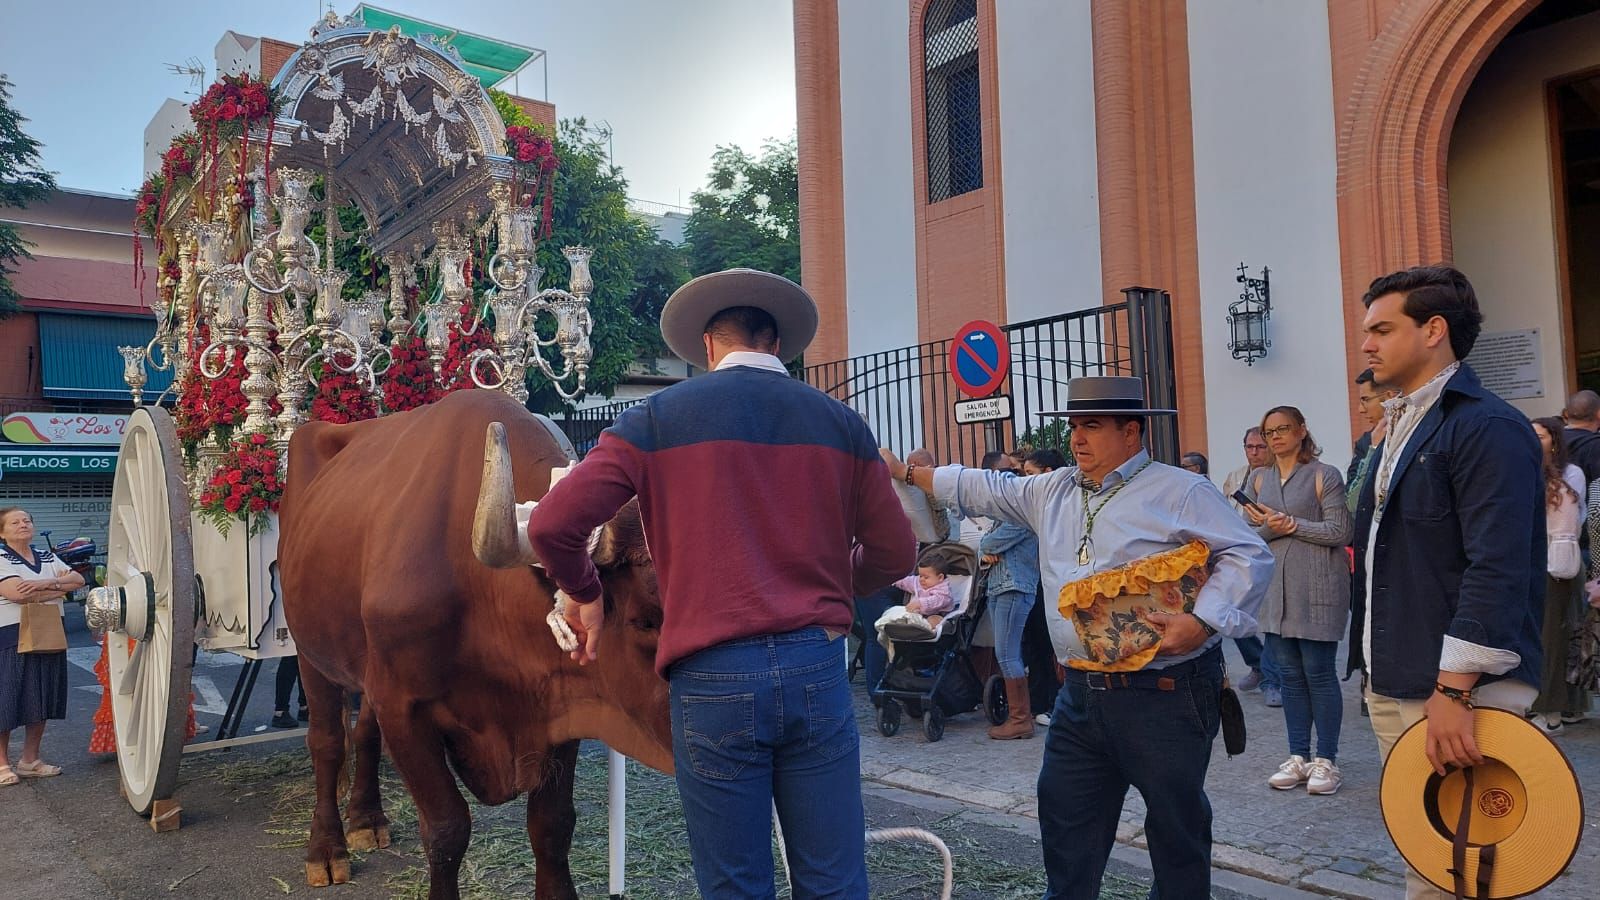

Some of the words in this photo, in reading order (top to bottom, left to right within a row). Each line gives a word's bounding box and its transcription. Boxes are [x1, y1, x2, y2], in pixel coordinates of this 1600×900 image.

[966, 402, 987, 411] SALIDA
[964, 409, 1001, 419] EMERGENCIA
[76, 416, 112, 434] Los
[0, 456, 70, 468] HELADOS
[81, 458, 110, 468] LOS
